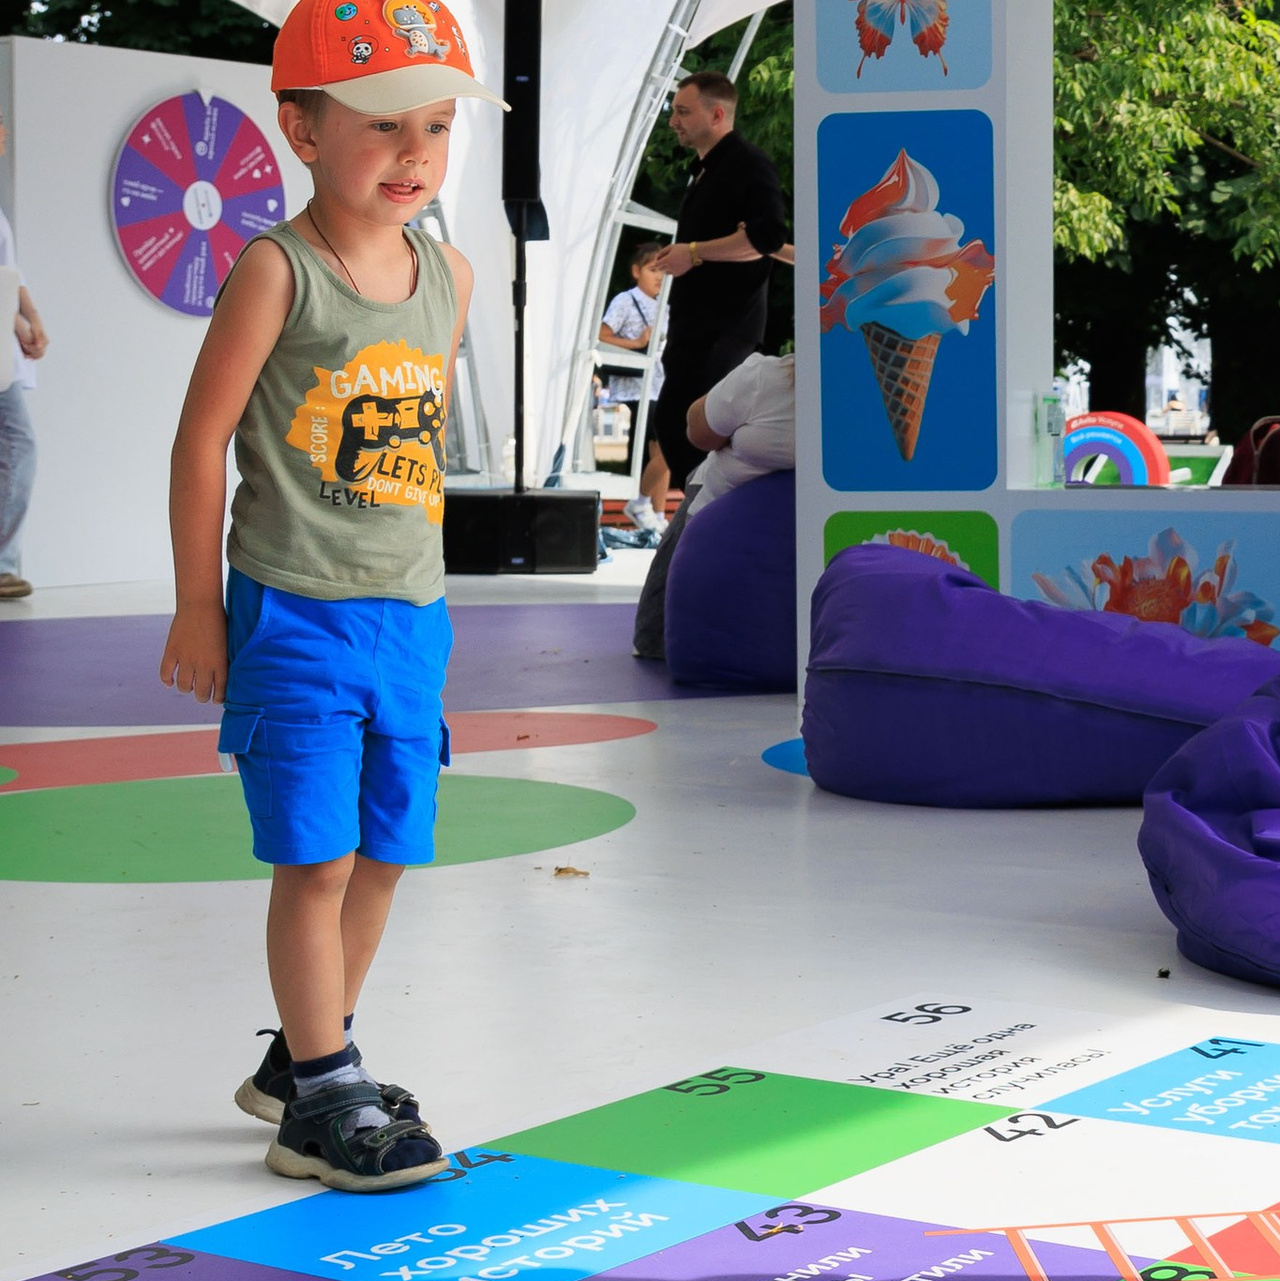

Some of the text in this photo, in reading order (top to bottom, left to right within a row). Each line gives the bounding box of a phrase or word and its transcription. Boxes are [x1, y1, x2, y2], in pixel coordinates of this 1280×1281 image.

[330, 362, 443, 402] GAMING
[311, 416, 328, 463] SCORE
[377, 452, 427, 486] LETS
[319, 482, 380, 508] LEVEL
[367, 477, 402, 496] DONT
[405, 487, 428, 504] GIVE
[880, 1003, 972, 1025] 56
[847, 1022, 1037, 1084] Ура! Ещё одна
[1189, 1037, 1265, 1059] 41
[664, 1067, 767, 1098] 55
[892, 1048, 1011, 1089] хорошая
[931, 1055, 1041, 1095] история
[1107, 1068, 1243, 1116] Услуги
[983, 1113, 1081, 1142] 42
[379, 1199, 628, 1281] хороших
[734, 1205, 842, 1241] 43
[320, 1223, 466, 1270] Лето
